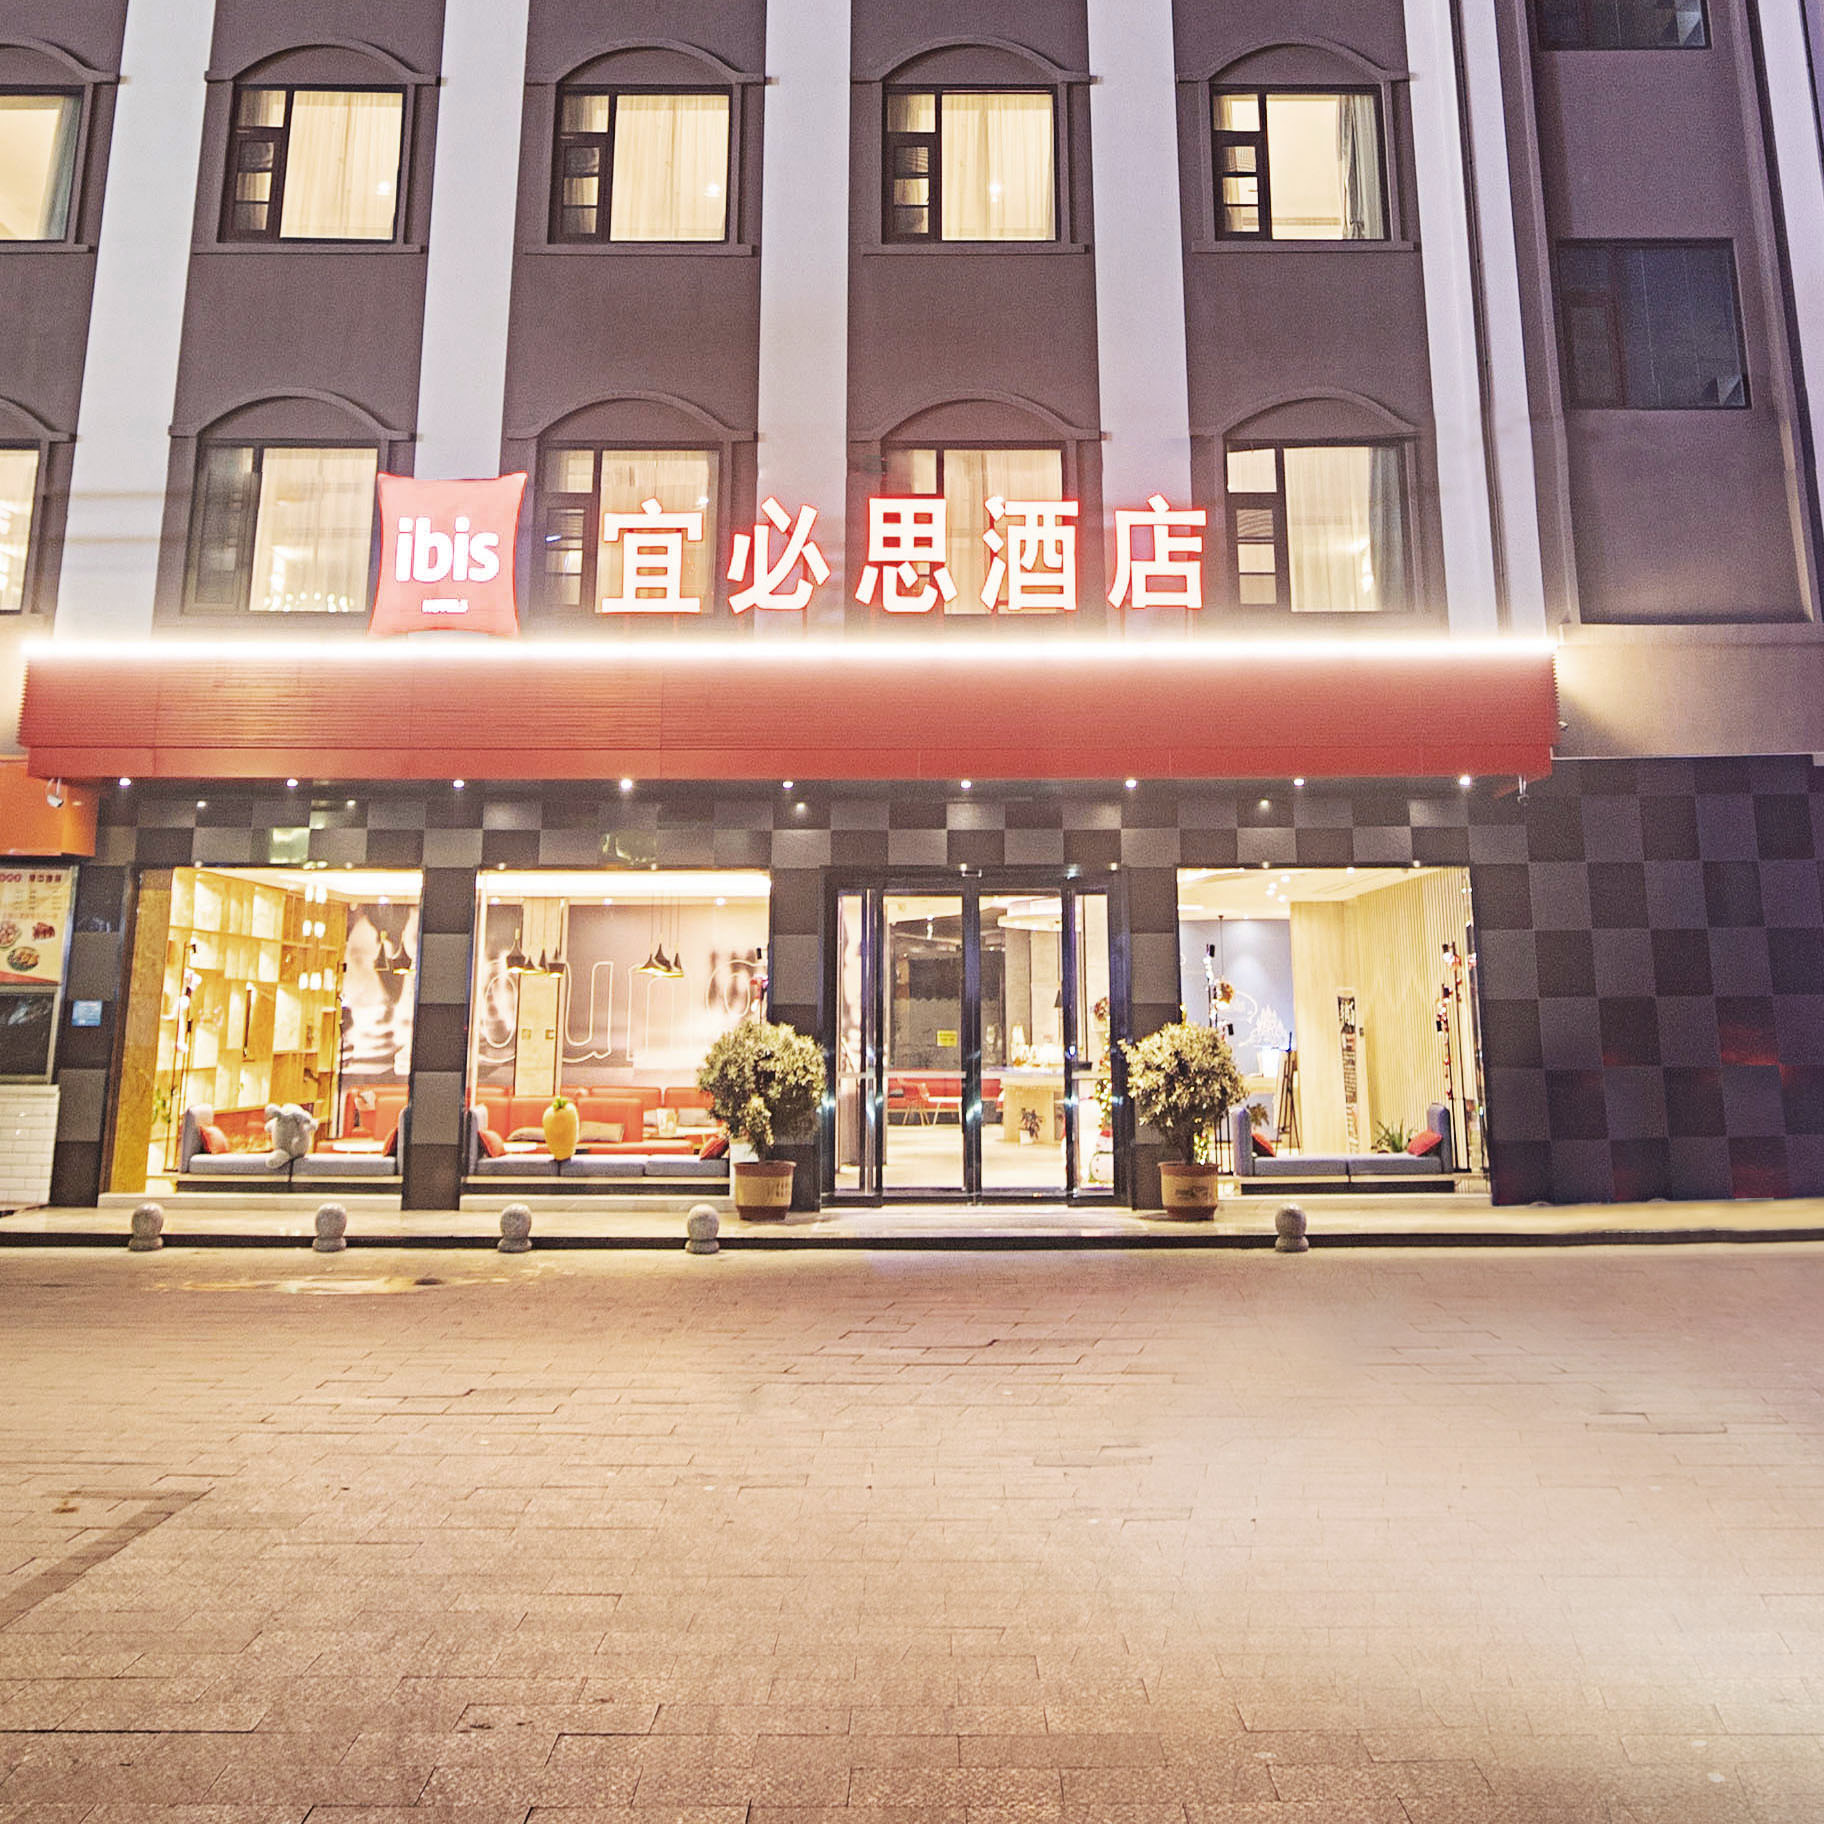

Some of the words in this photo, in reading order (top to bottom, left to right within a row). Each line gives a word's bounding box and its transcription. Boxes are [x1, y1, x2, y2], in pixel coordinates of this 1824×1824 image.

[394, 516, 501, 584] ibis
[602, 494, 1207, 615] 宜必思酒店
